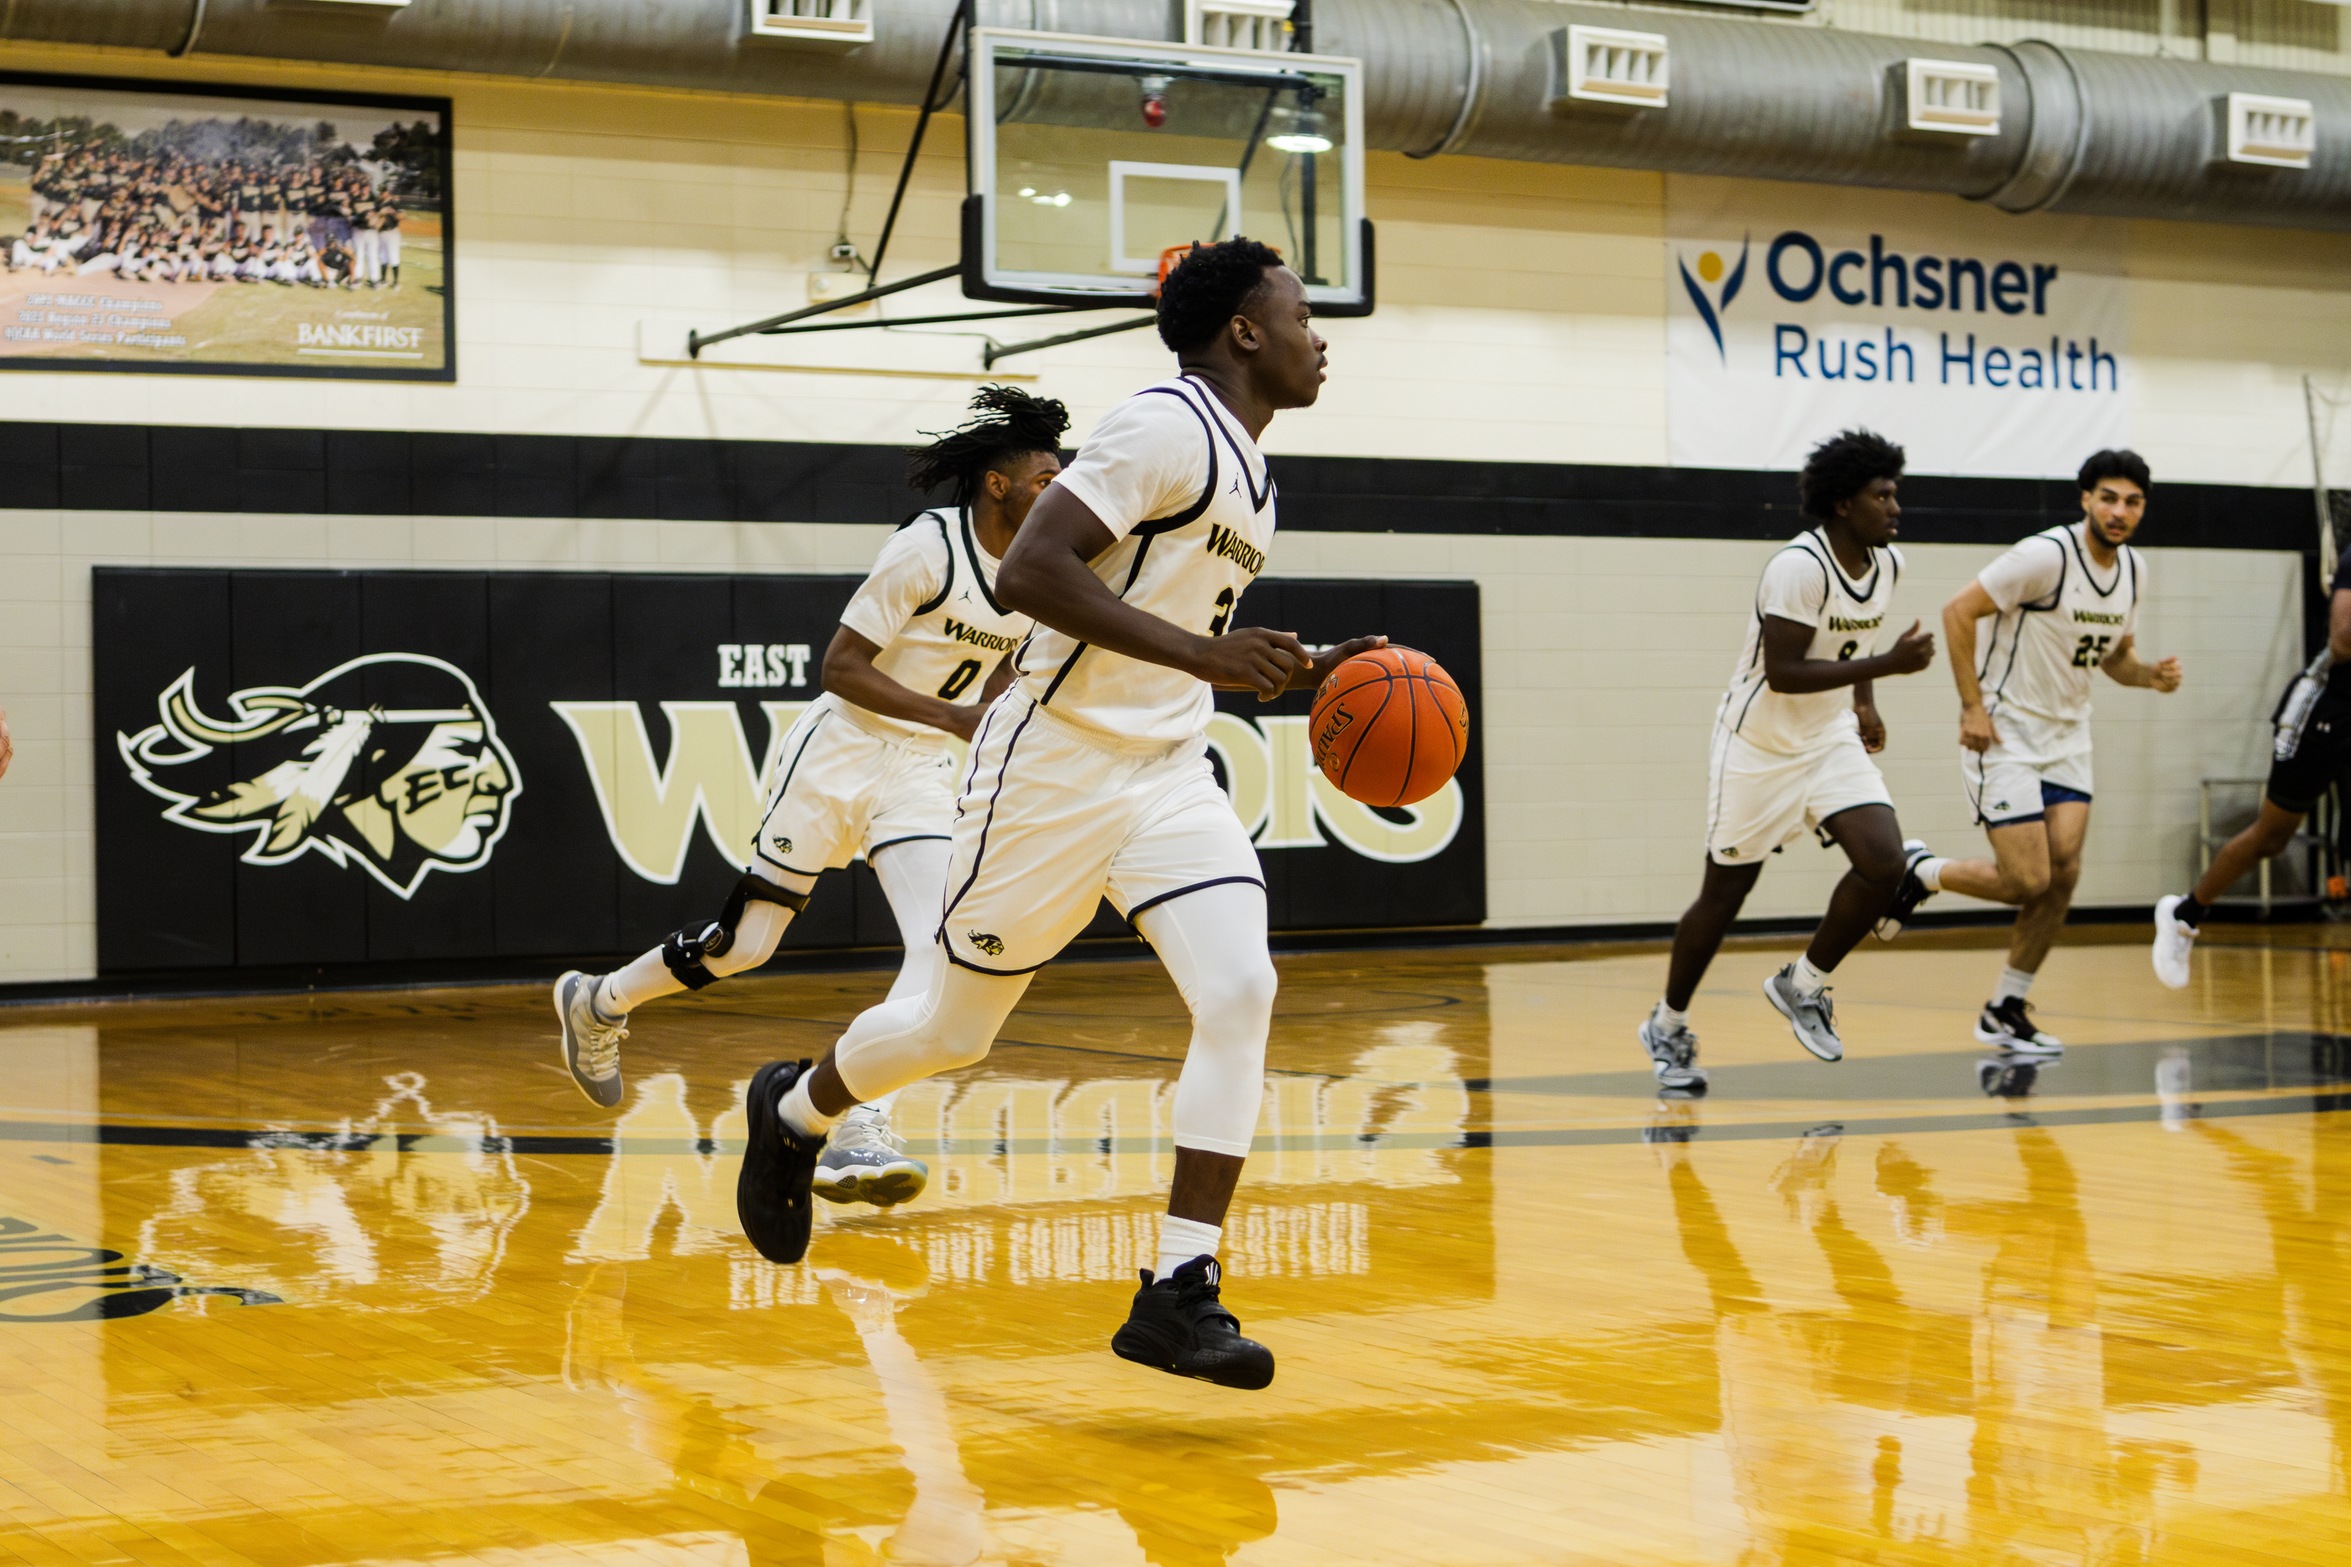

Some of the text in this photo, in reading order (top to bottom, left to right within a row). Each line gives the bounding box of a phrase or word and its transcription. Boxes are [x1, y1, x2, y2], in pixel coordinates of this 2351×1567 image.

[1766, 231, 2058, 315] Ochsner
[298, 322, 423, 349] BANKFIRST
[1774, 322, 2118, 391] Rush Health
[717, 644, 811, 687] EAST
[2071, 633, 2112, 667] 25
[937, 658, 982, 701] 0
